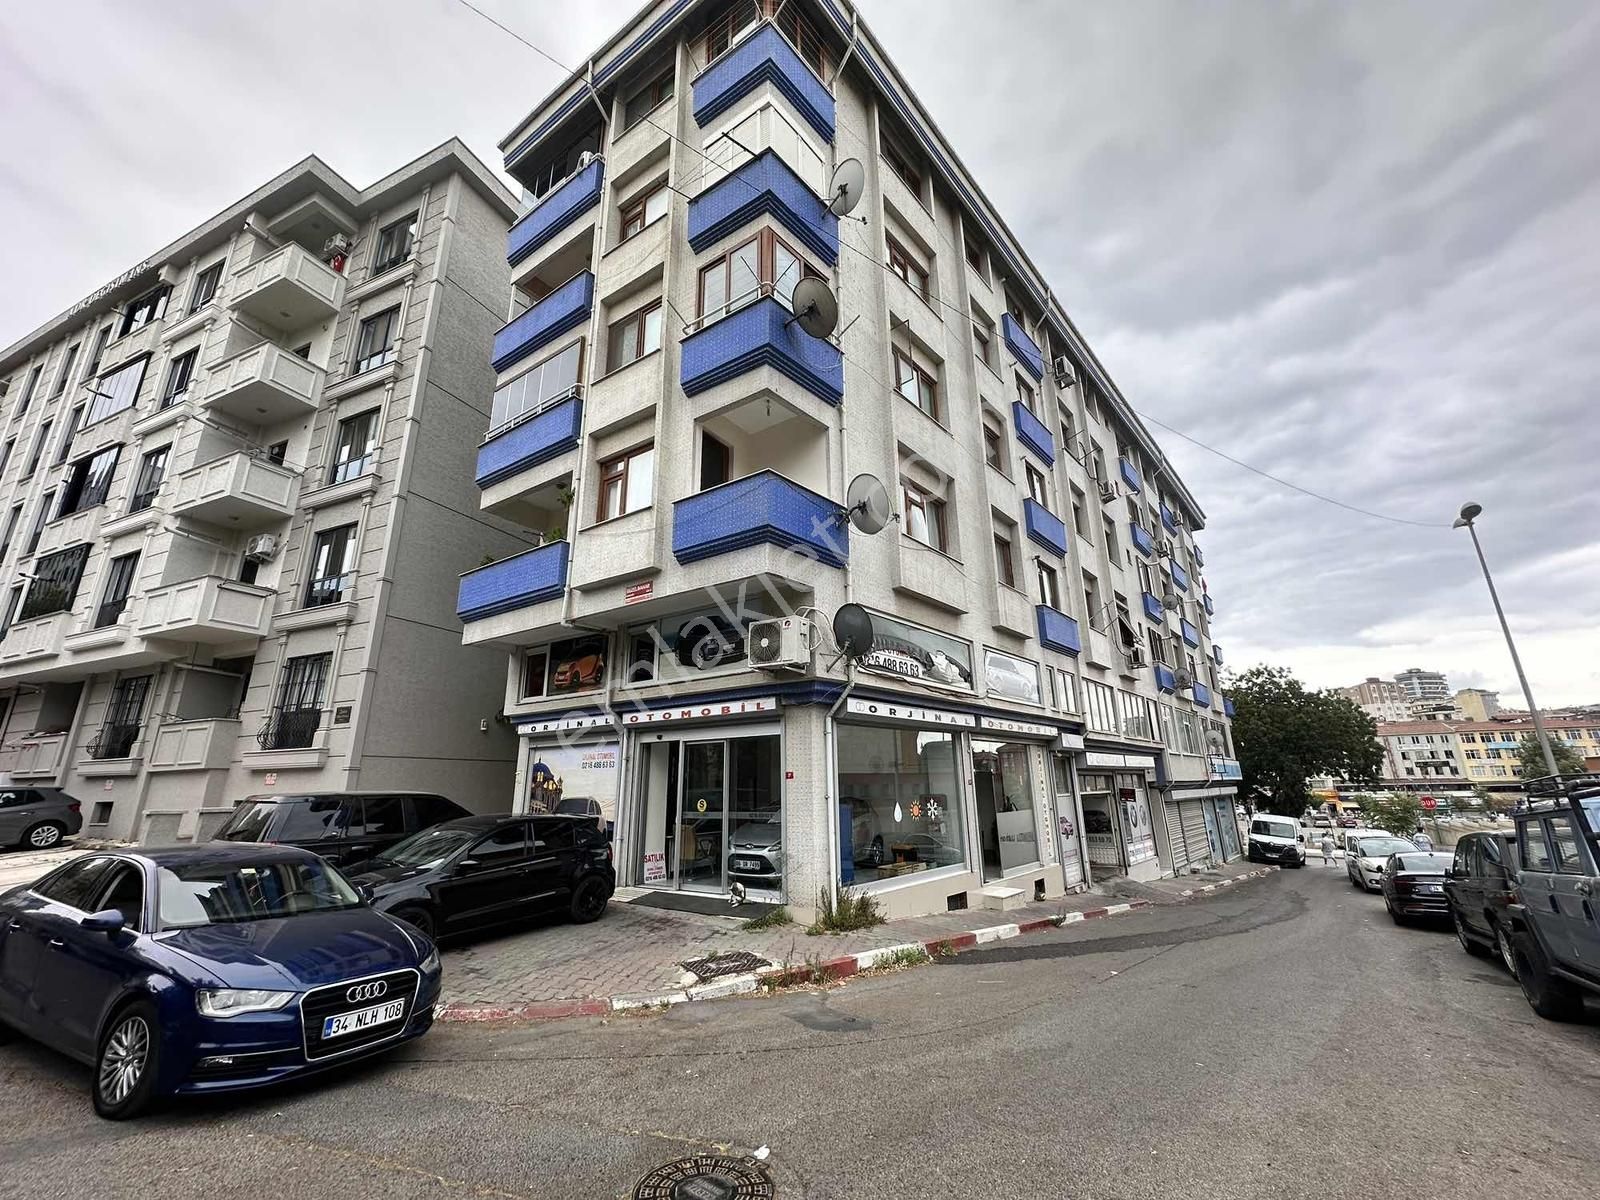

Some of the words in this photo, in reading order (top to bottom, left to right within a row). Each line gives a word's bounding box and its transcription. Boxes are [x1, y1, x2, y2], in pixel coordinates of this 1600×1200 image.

[899, 659, 909, 675] 63
[910, 662, 920, 678] 63
[630, 702, 765, 723] OTOMOBİL
[332, 1017, 348, 1034] 34
[355, 1008, 379, 1028] NLH
[383, 1002, 402, 1020] 108
